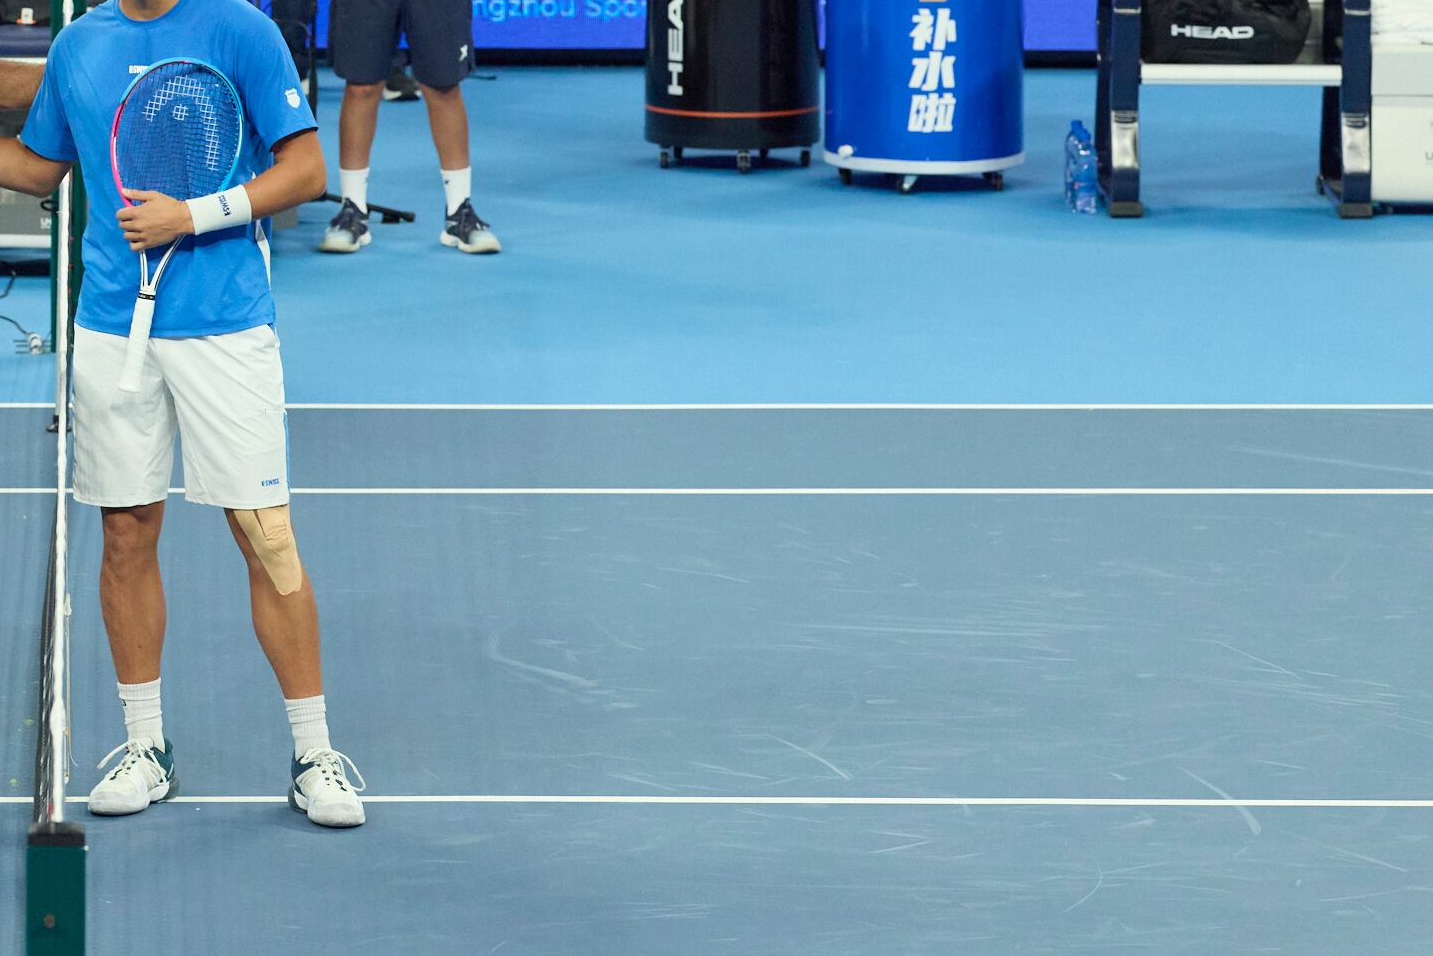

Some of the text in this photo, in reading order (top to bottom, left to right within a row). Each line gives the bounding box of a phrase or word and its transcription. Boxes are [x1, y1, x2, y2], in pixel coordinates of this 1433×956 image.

[1170, 24, 1255, 39] HEAD
[908, 8, 957, 133] 补水啦
